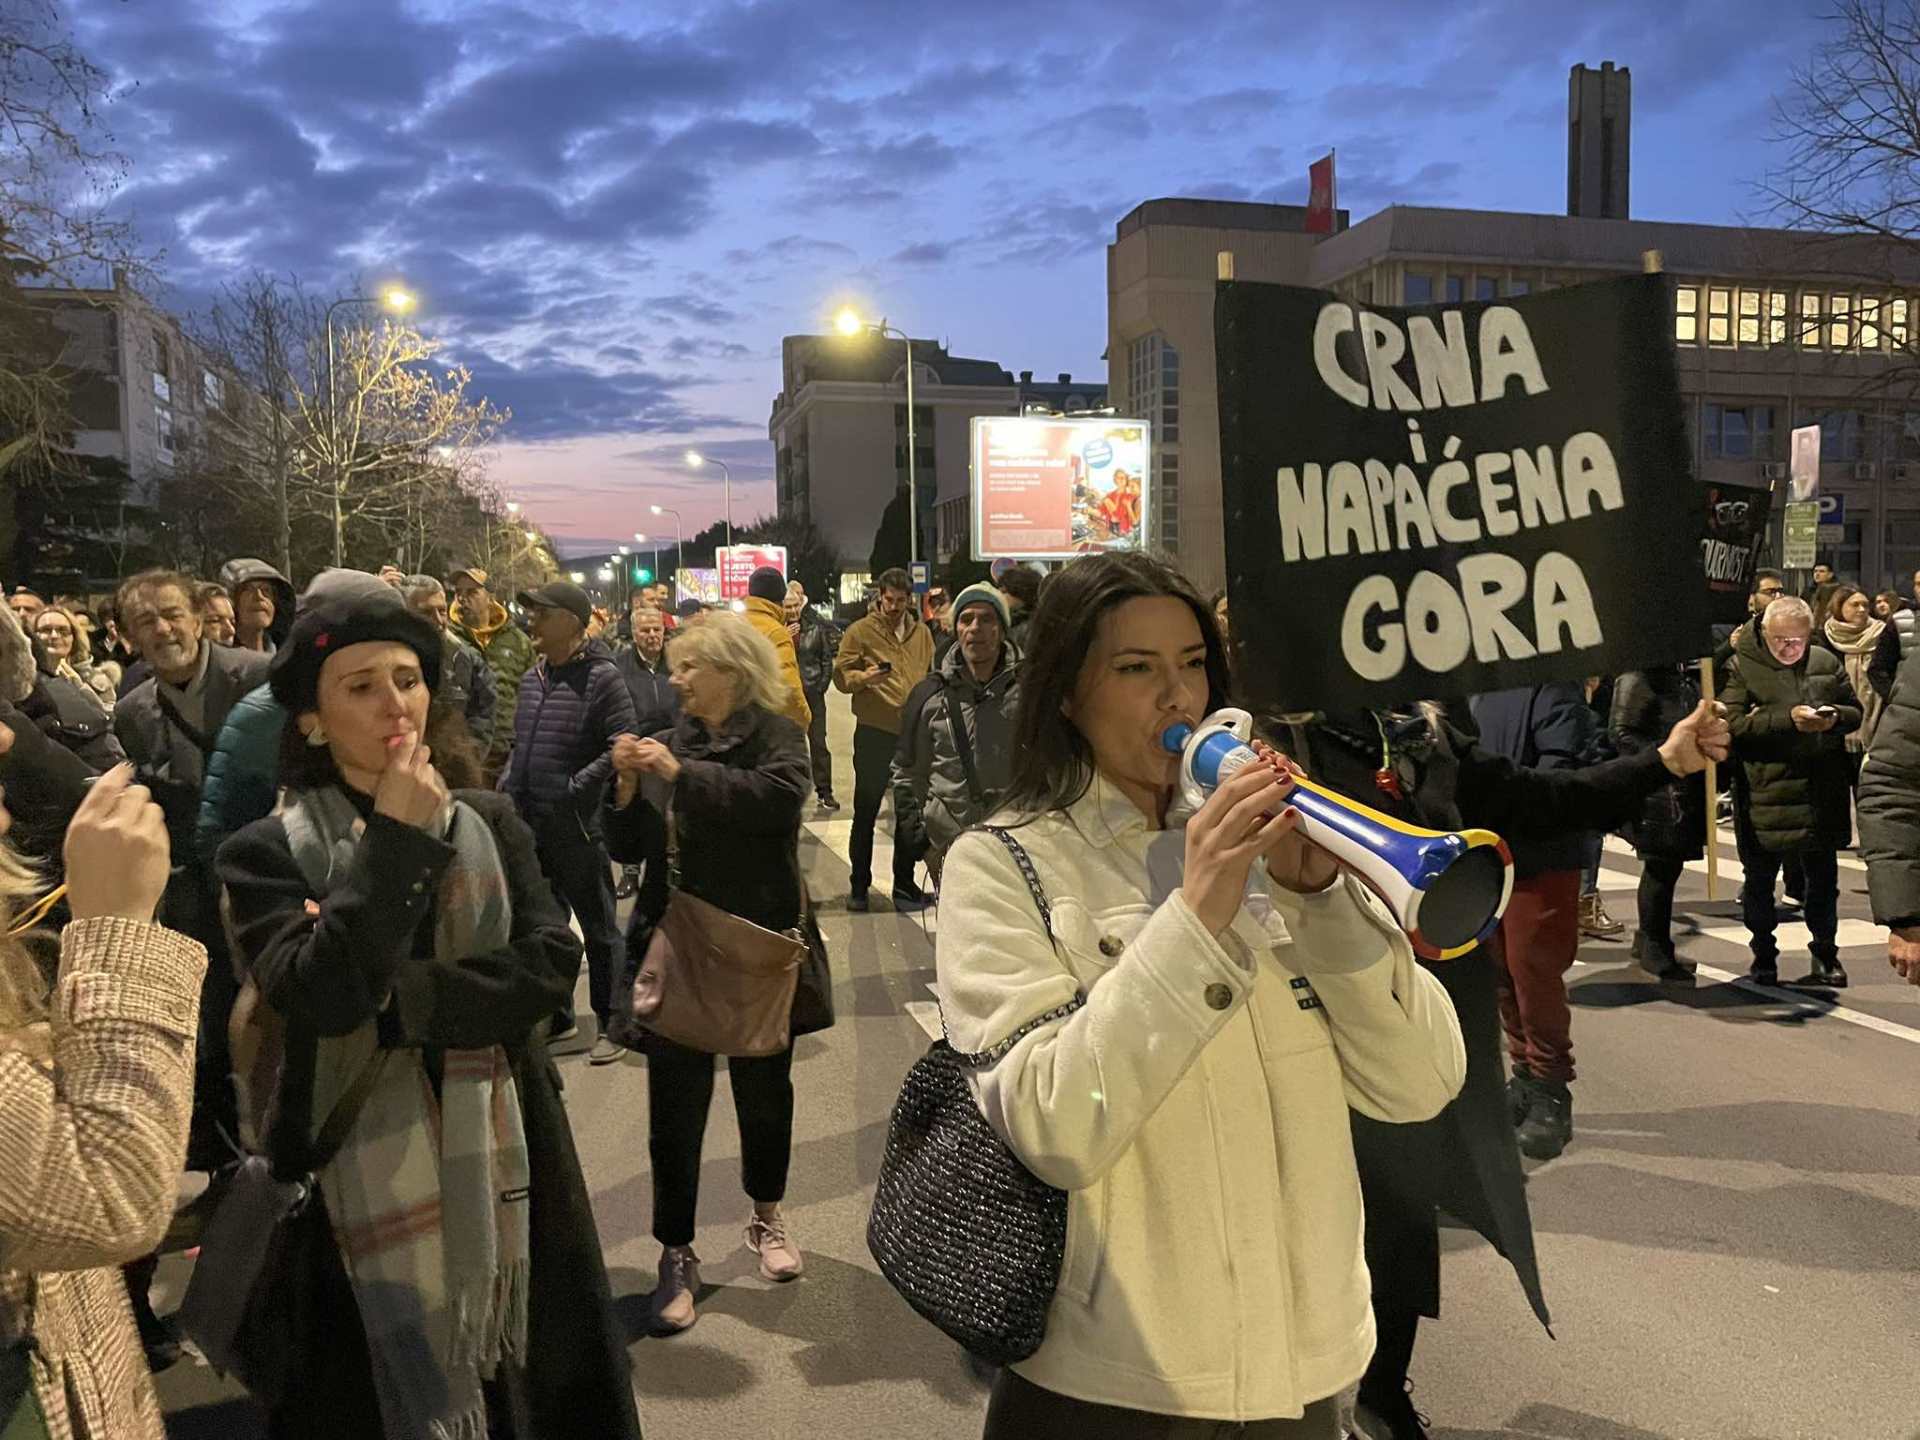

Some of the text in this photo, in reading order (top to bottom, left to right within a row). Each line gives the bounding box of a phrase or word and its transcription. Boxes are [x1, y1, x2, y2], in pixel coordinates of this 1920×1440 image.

[1313, 302, 1550, 411] CRNA
[1277, 432, 1625, 562] NAPAĆENA
[1407, 418, 1428, 464] i
[1341, 551, 1604, 682] GORA
